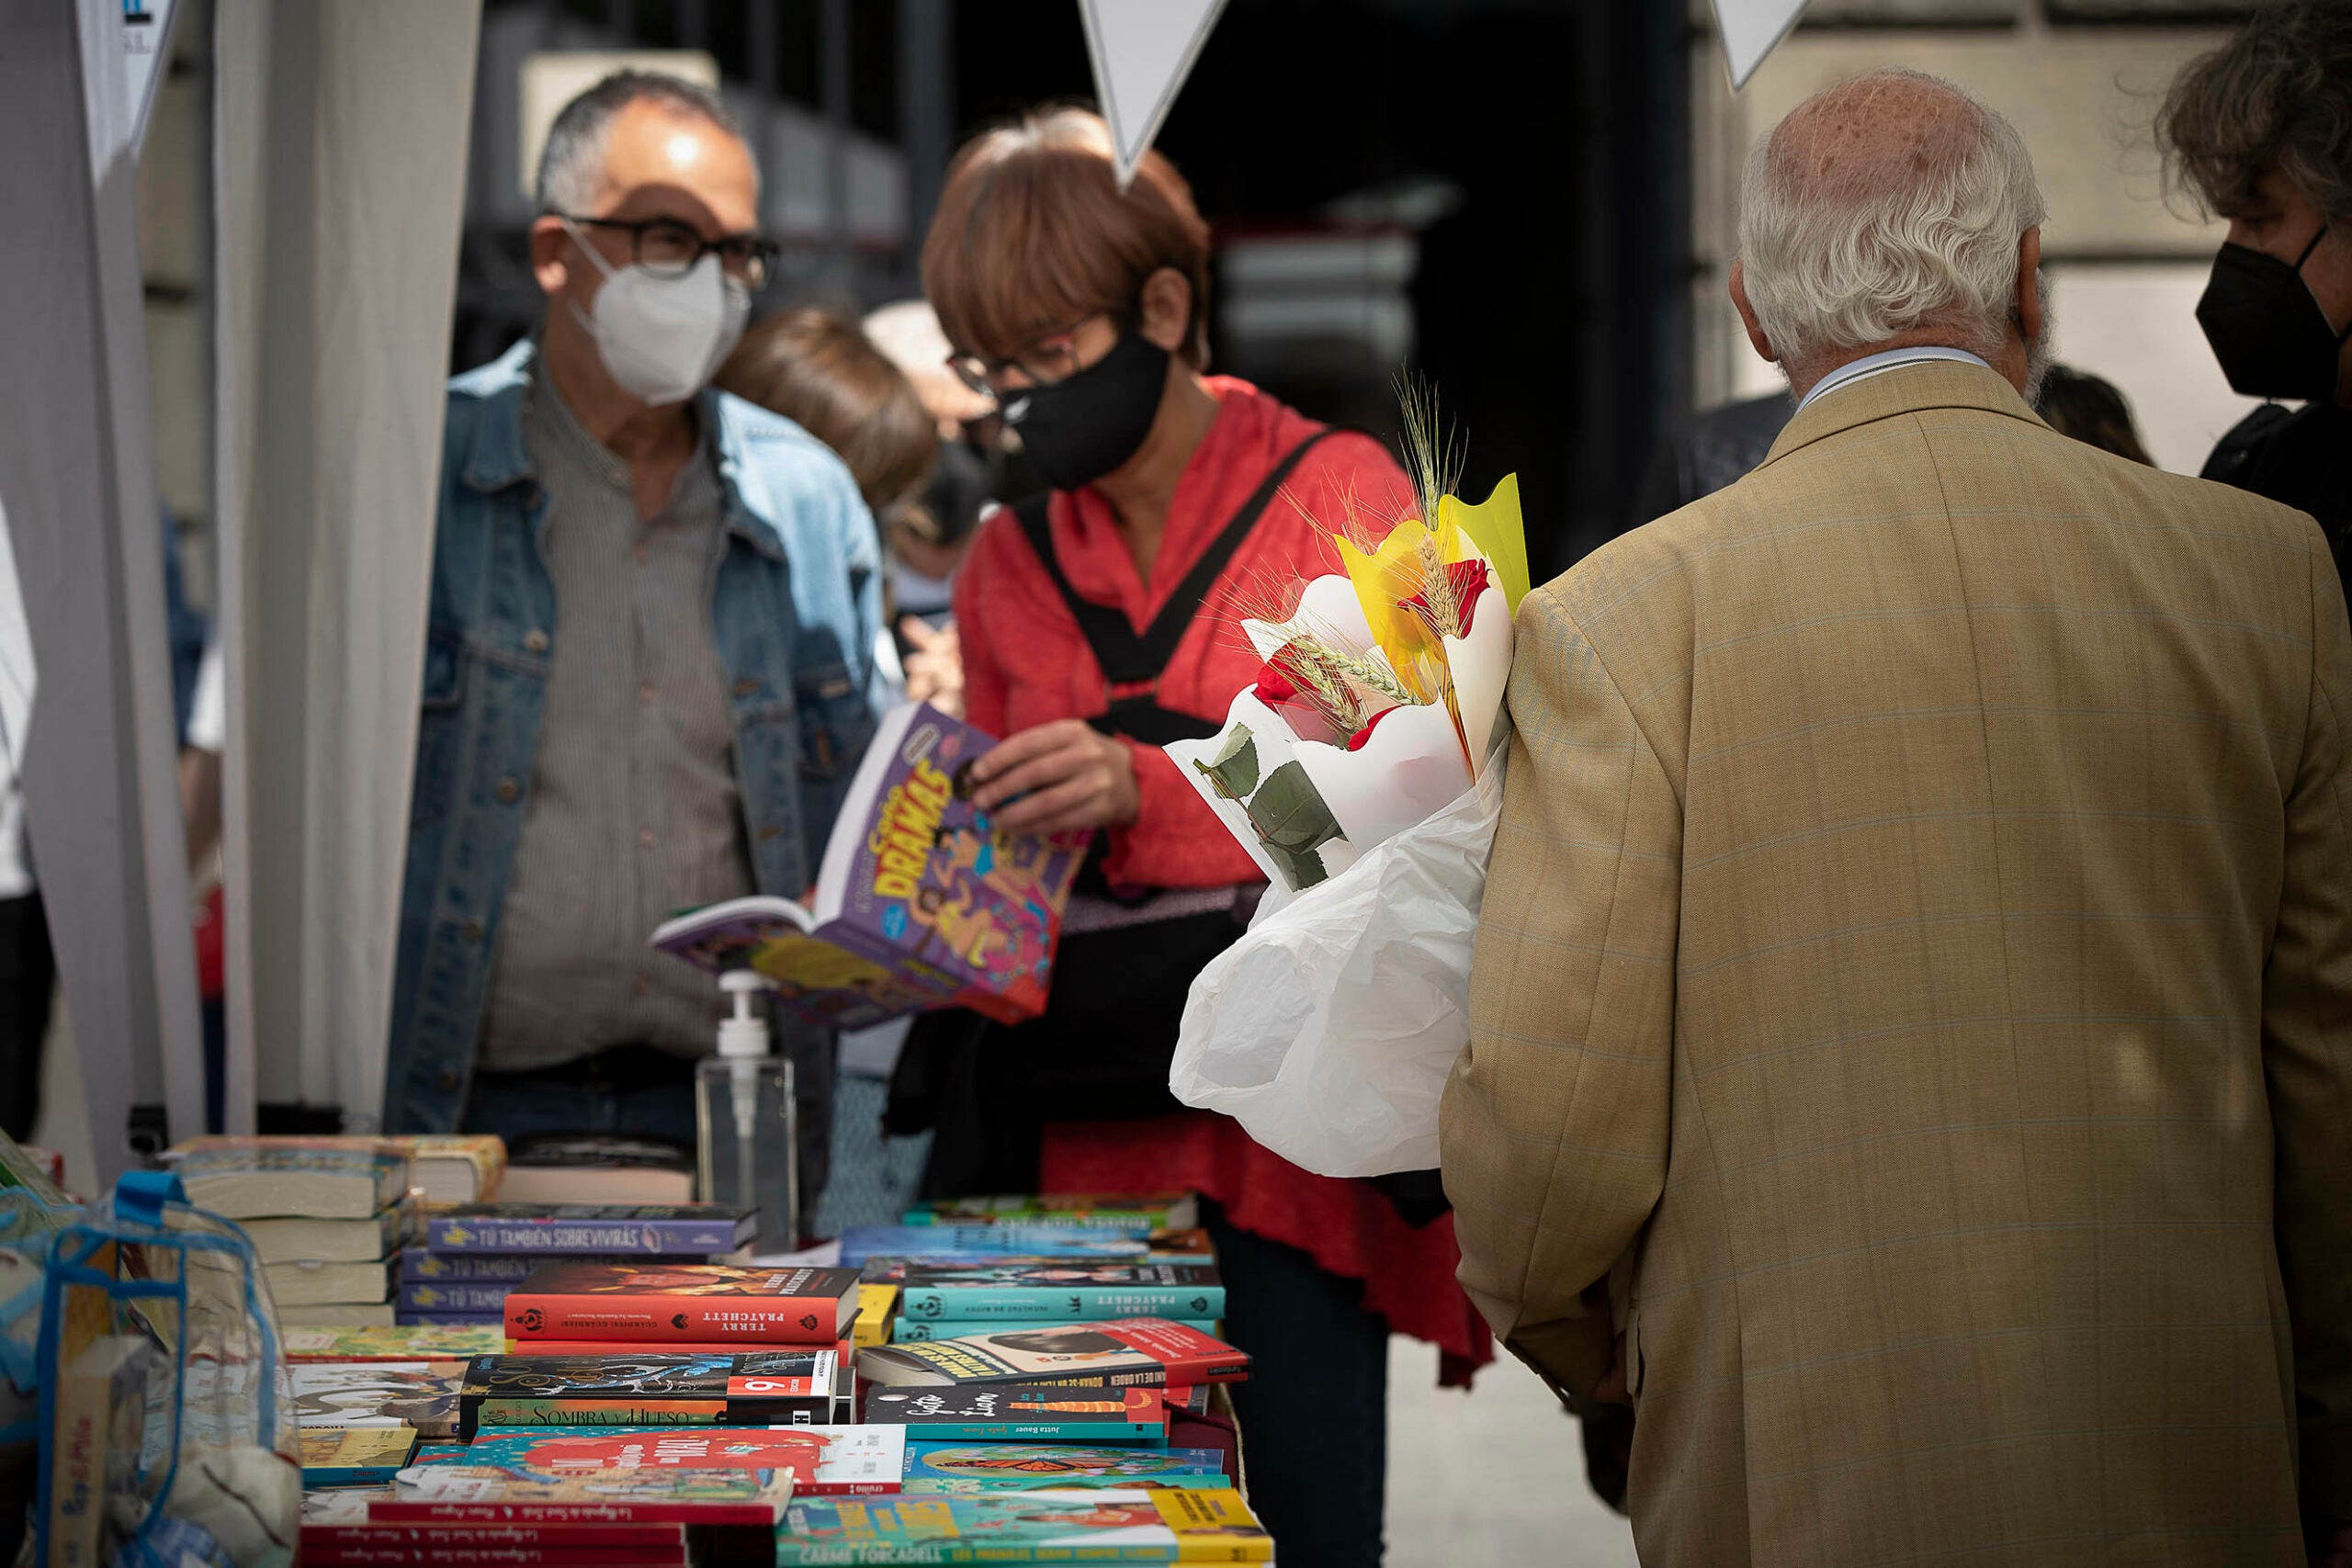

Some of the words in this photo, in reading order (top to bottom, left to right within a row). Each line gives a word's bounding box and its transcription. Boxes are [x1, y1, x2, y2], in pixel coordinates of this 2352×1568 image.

[874, 758, 953, 899] DRAMAS
[479, 1226, 494, 1247] TÚ
[497, 1225, 551, 1247] TAMBIÉN
[553, 1225, 640, 1248] SOBREVIVIRÁS
[1097, 1295, 1176, 1304] PRATCHETT
[1115, 1306, 1158, 1314] TERRY
[703, 1313, 784, 1322] PRATCHETT
[721, 1323, 766, 1331] TERRY
[1135, 1373, 1144, 1384] LA
[1144, 1372, 1154, 1384] DE
[1154, 1372, 1165, 1382] ANI
[531, 1404, 606, 1426] SOMBRA
[628, 1407, 690, 1426] HUESO
[1015, 1426, 1039, 1434] Bauer
[799, 1548, 854, 1565] CARME
[858, 1547, 944, 1564] FORCADELL
